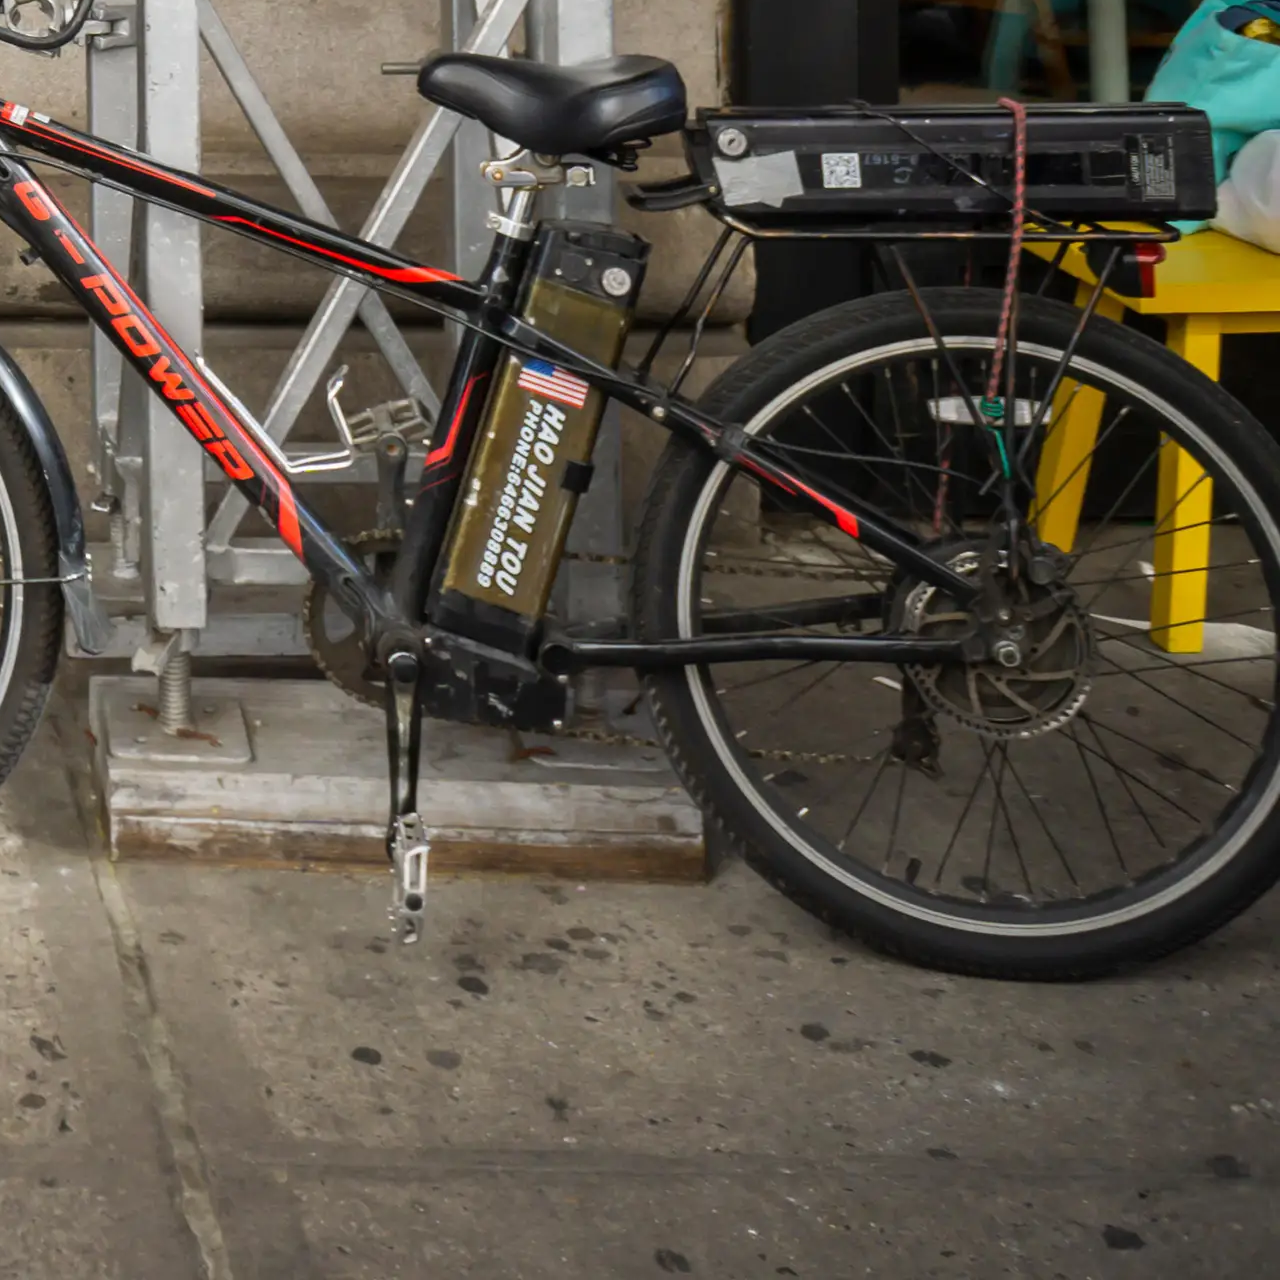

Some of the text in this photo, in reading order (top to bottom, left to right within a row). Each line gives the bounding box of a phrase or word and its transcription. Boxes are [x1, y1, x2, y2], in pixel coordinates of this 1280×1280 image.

[494, 402, 567, 597] HAO JIAN TOU
